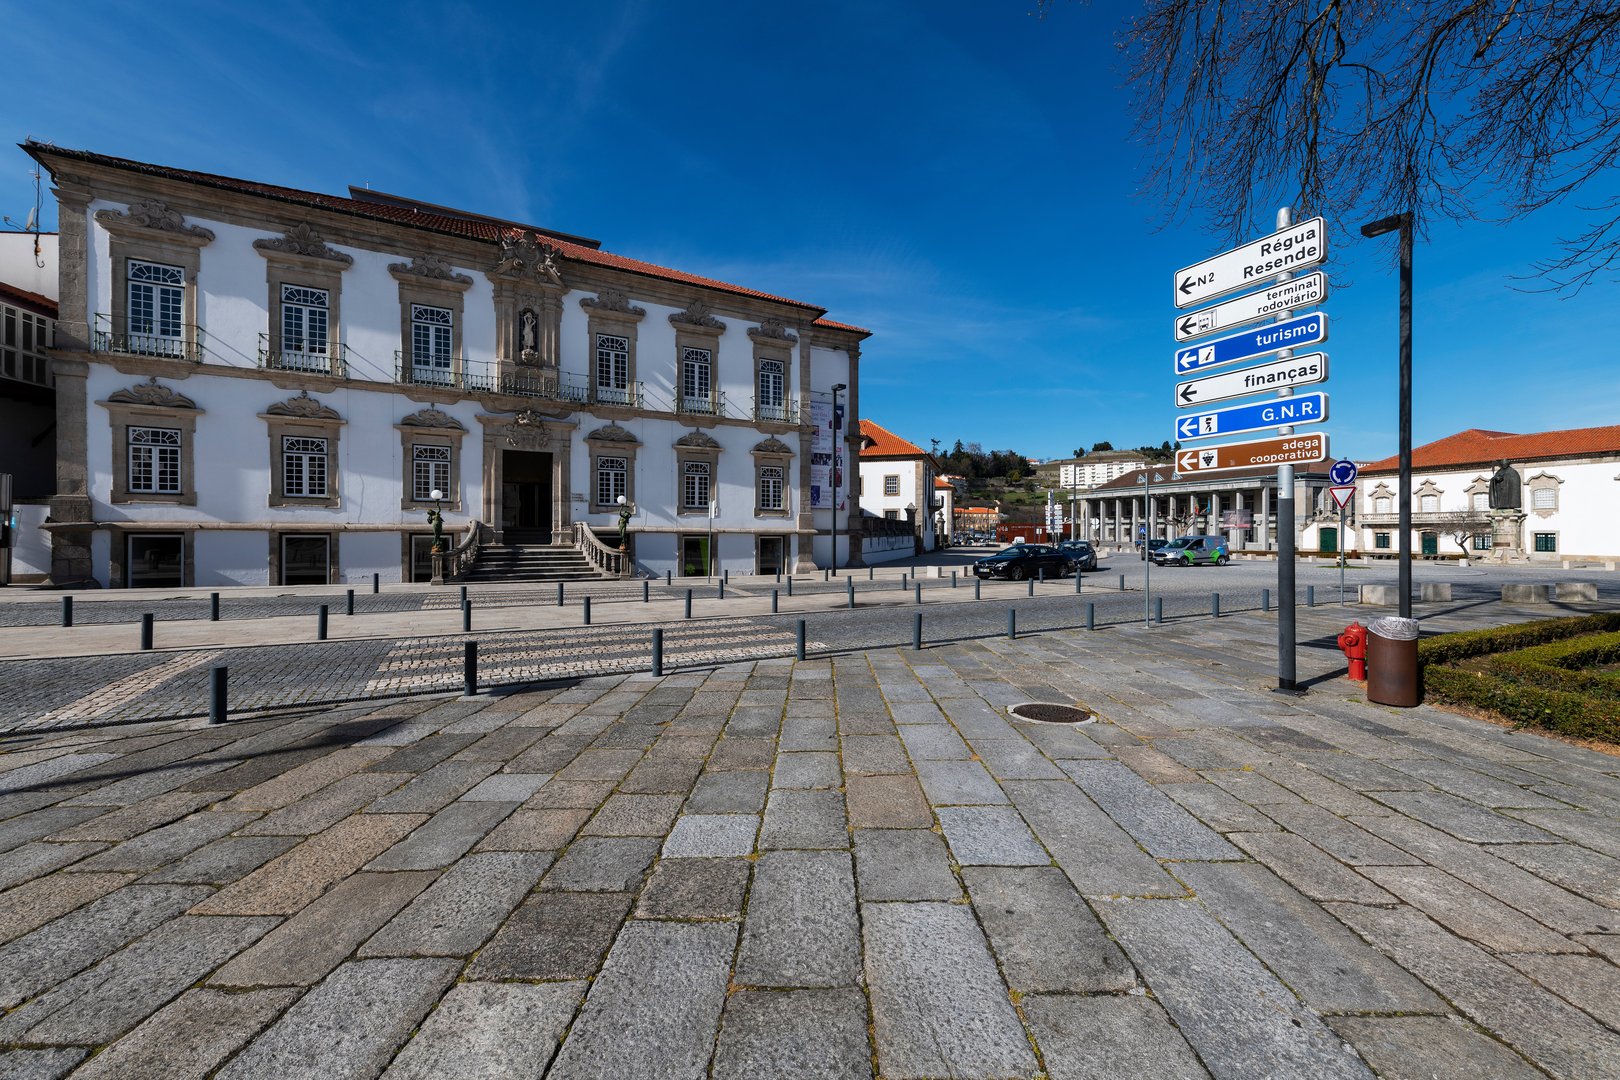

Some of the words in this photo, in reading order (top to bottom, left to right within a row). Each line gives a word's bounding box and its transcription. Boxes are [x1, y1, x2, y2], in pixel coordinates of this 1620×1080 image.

[1260, 228, 1316, 257] Régua
[1243, 246, 1317, 279] Resende
[1197, 272, 1215, 287] N2
[1266, 277, 1317, 301] terminal
[1257, 290, 1318, 314] rodoviário
[1255, 322, 1318, 346] turismo
[1244, 364, 1318, 388] finanças
[1262, 401, 1318, 422] G.N.R.
[1250, 449, 1319, 464] cooperativa
[1282, 439, 1319, 451] adega
